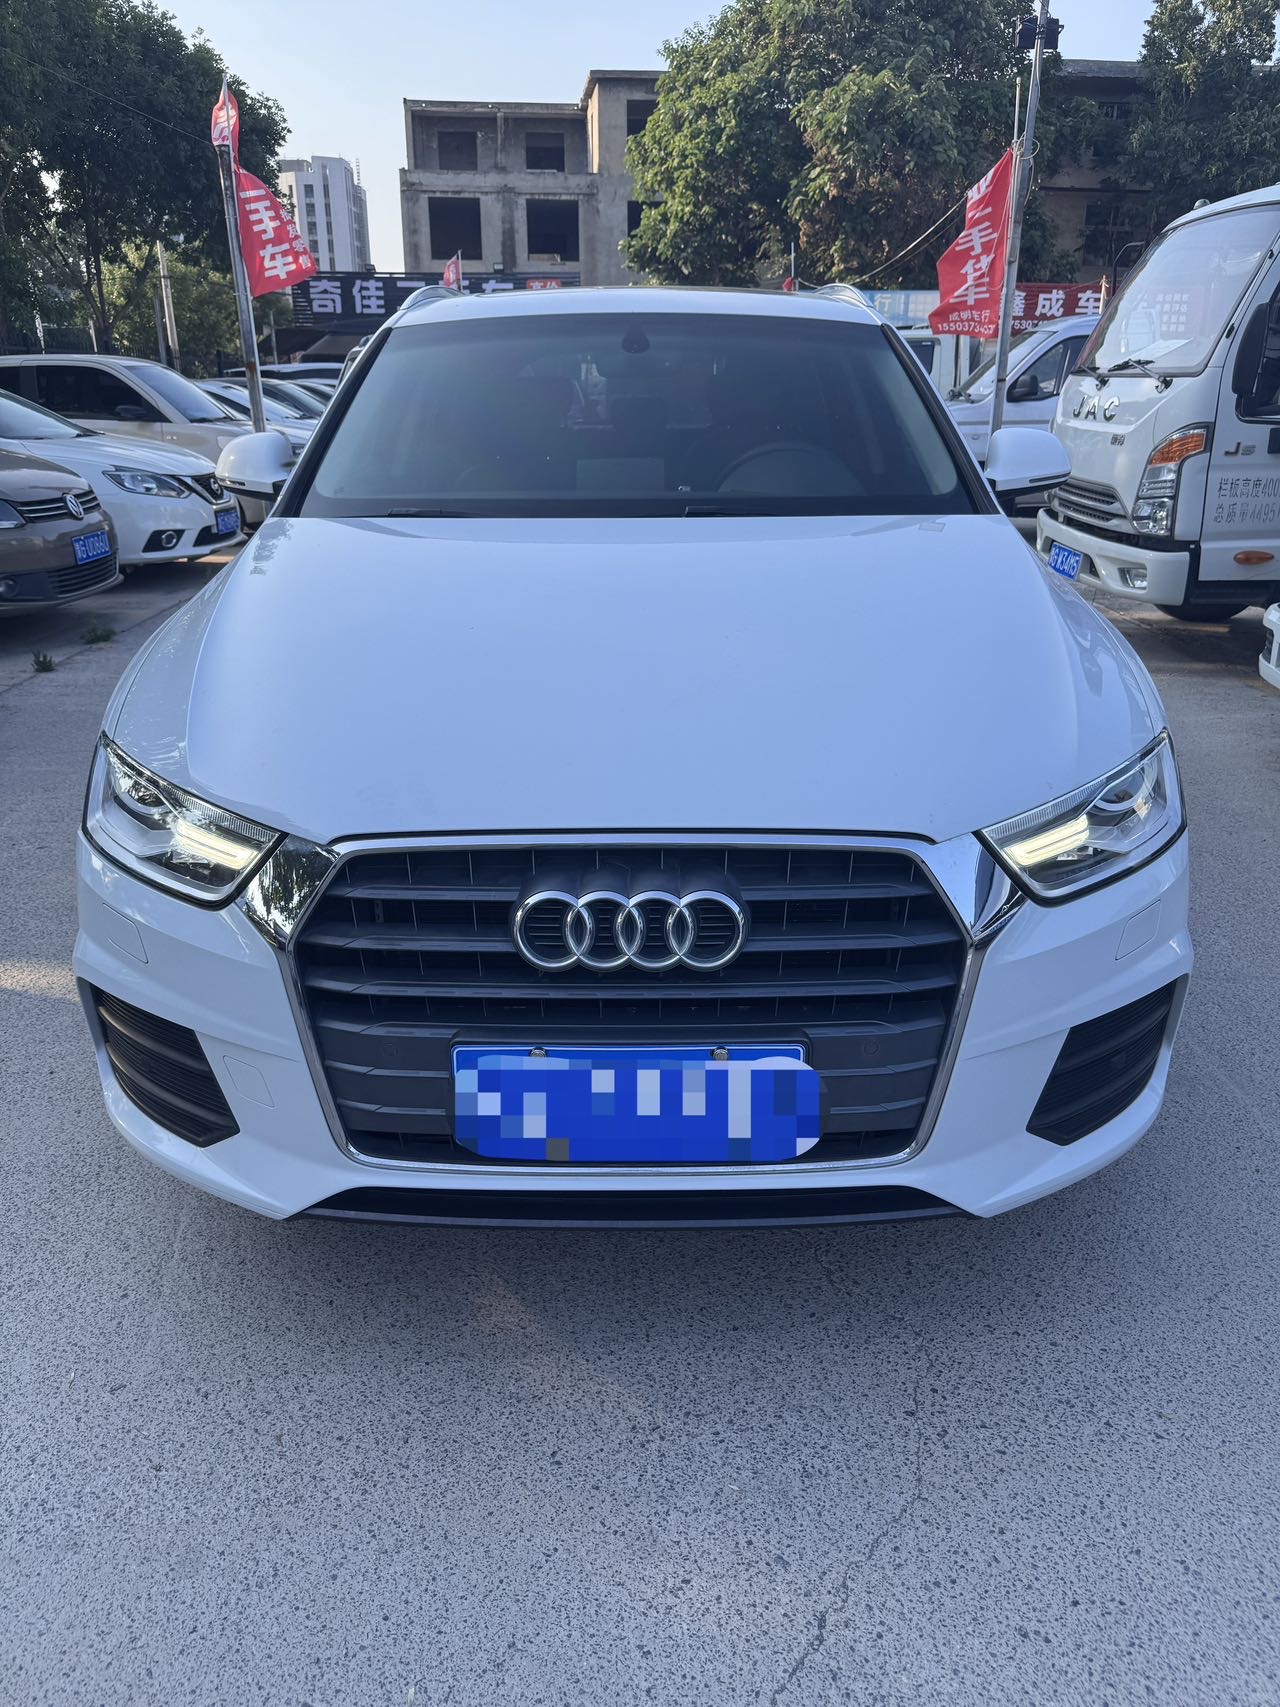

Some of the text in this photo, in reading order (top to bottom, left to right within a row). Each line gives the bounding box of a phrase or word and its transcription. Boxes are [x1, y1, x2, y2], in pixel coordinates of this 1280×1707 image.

[239, 188, 296, 279] 二手车
[1073, 395, 1120, 422] JAC
[1217, 477, 1280, 499] 栏板高度400
